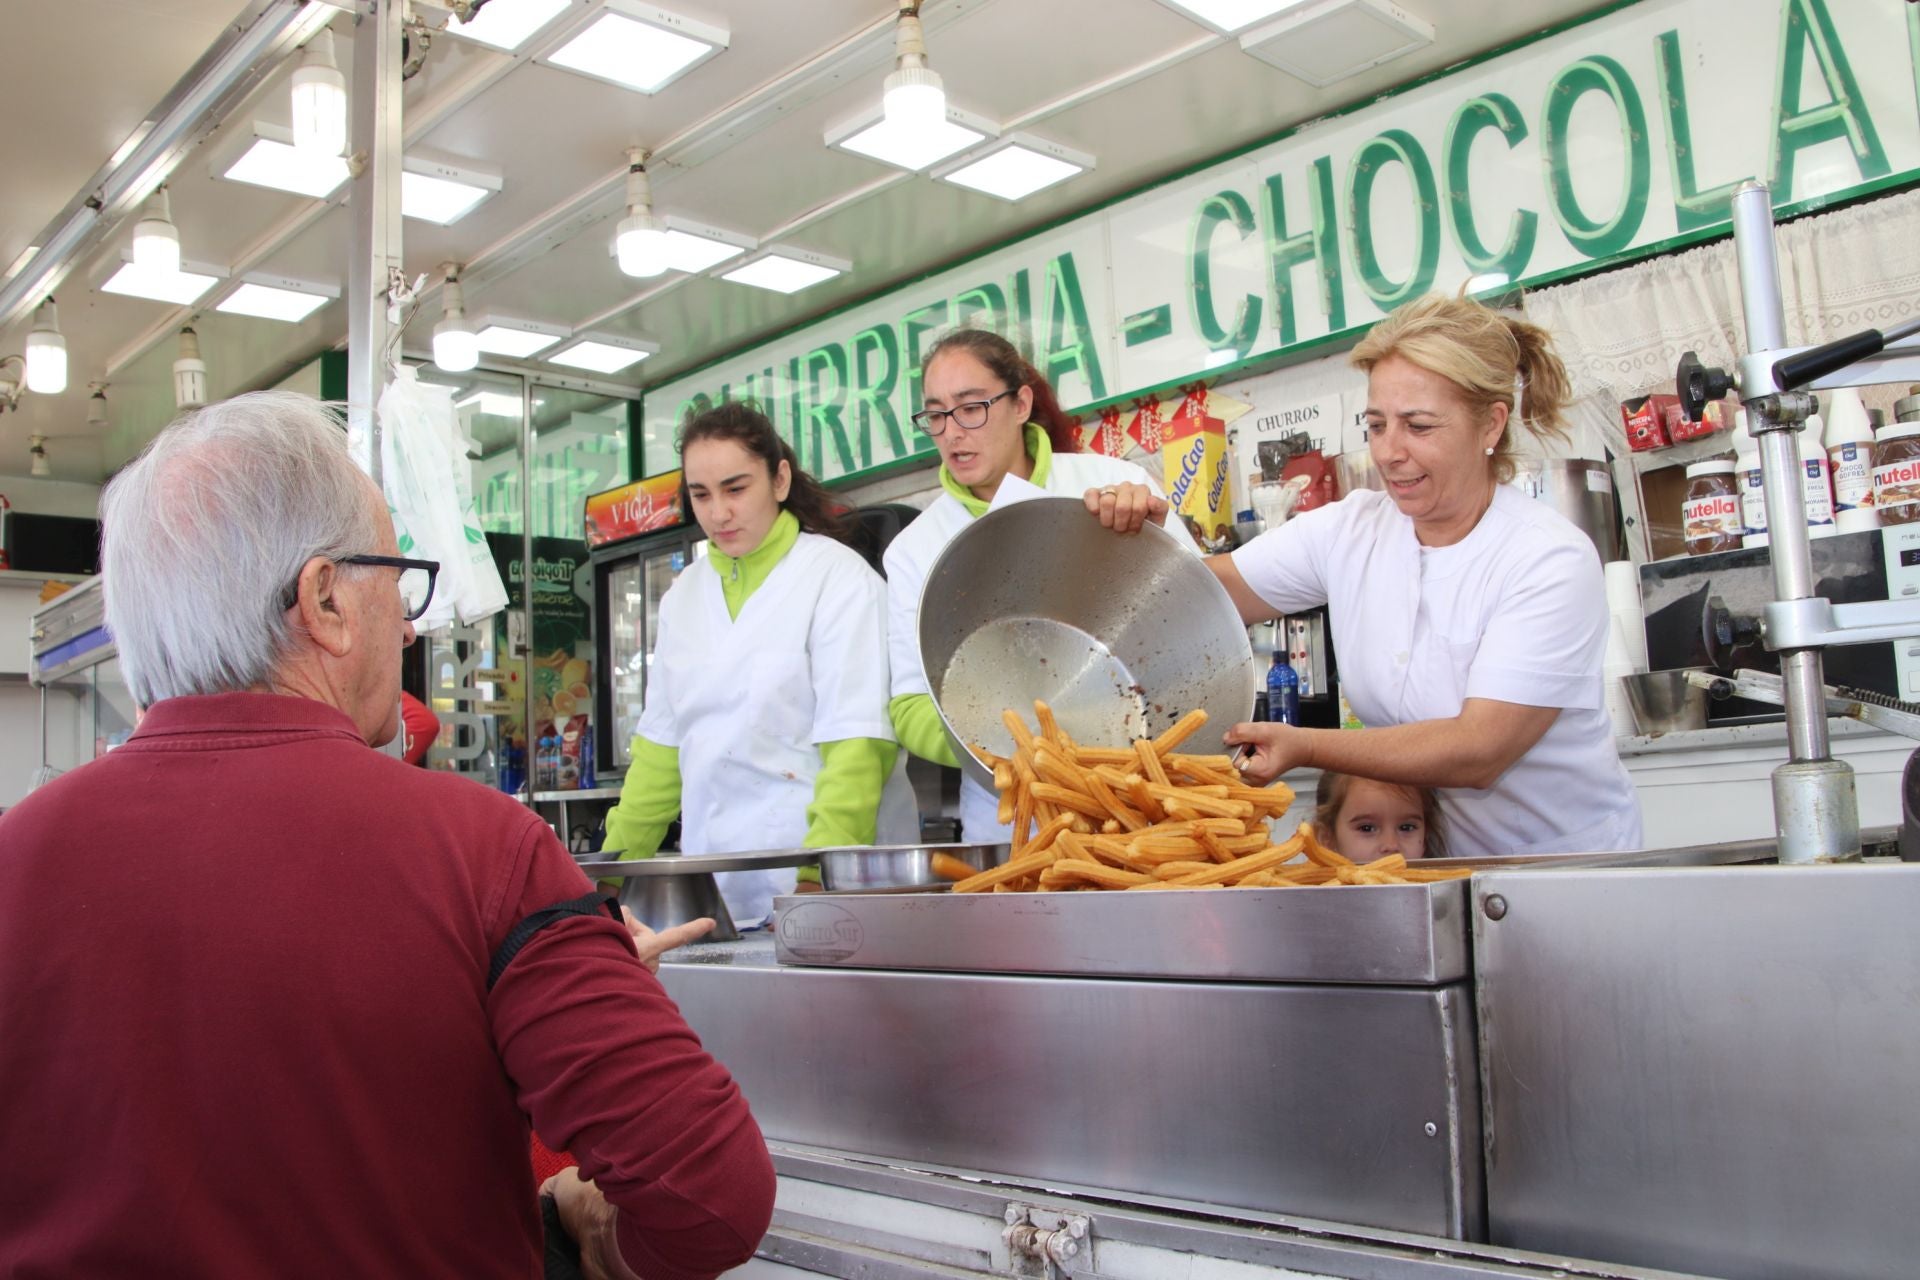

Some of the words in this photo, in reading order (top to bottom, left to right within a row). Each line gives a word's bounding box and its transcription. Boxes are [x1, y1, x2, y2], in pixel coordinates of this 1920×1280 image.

[1187, 0, 1920, 357] CHOCOLA
[1257, 404, 1320, 433] CHURROS
[1167, 438, 1205, 513] olaCao
[1208, 452, 1229, 513] ColaCao
[1683, 498, 1735, 520] nutella
